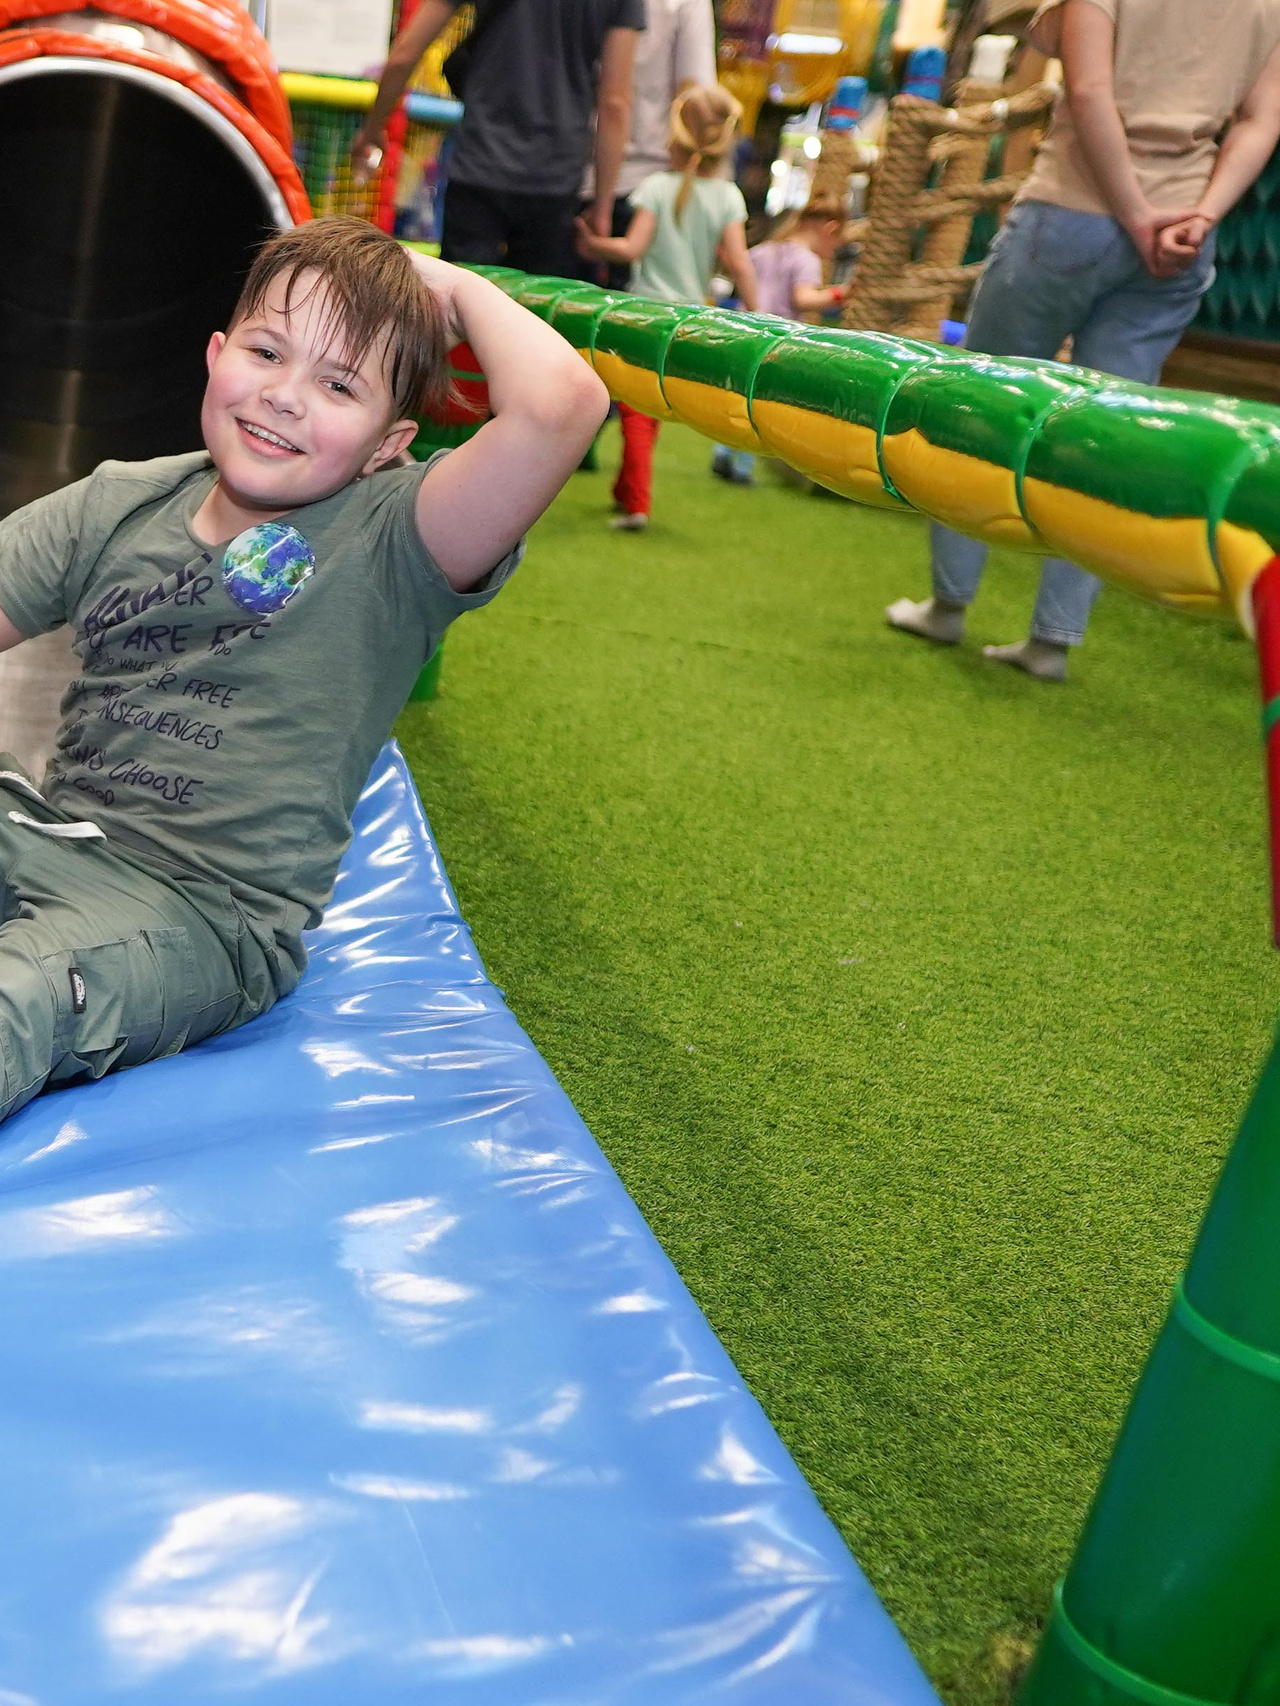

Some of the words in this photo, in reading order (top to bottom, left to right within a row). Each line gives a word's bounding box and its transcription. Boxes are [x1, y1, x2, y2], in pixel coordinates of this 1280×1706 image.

[122, 623, 194, 654] ARE
[119, 657, 159, 673] WHAT
[182, 678, 242, 709] FREE
[73, 776, 116, 807] GOOD
[108, 756, 205, 805] CHOOSE
